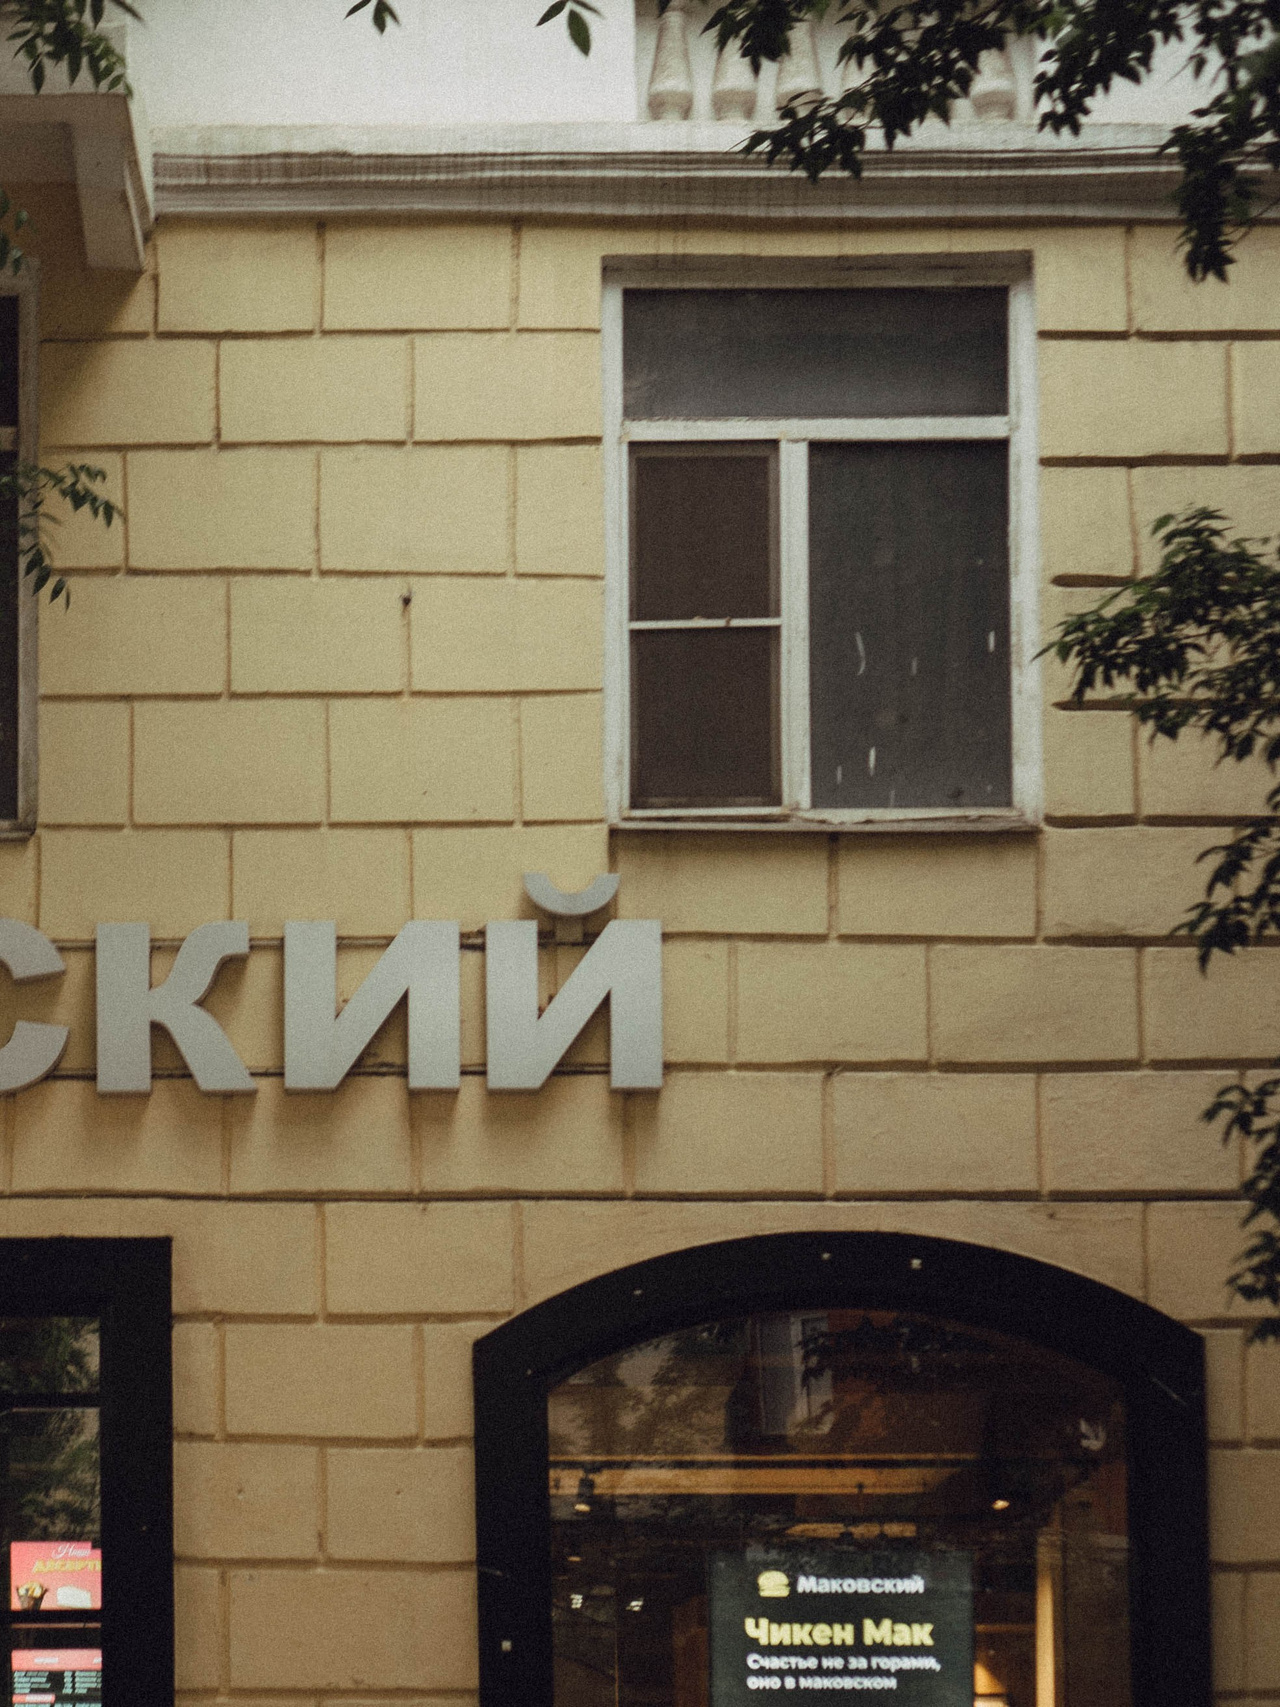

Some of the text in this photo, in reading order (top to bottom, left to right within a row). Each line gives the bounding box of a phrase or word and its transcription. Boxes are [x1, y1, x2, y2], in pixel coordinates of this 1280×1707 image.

[796, 1574, 925, 1594] Маковский
[744, 1617, 935, 1646] Чикен Мак
[746, 1653, 819, 1670] Счастье
[821, 1656, 845, 1670] не
[847, 1656, 868, 1670] за
[746, 1675, 898, 1690] оно в маковском
